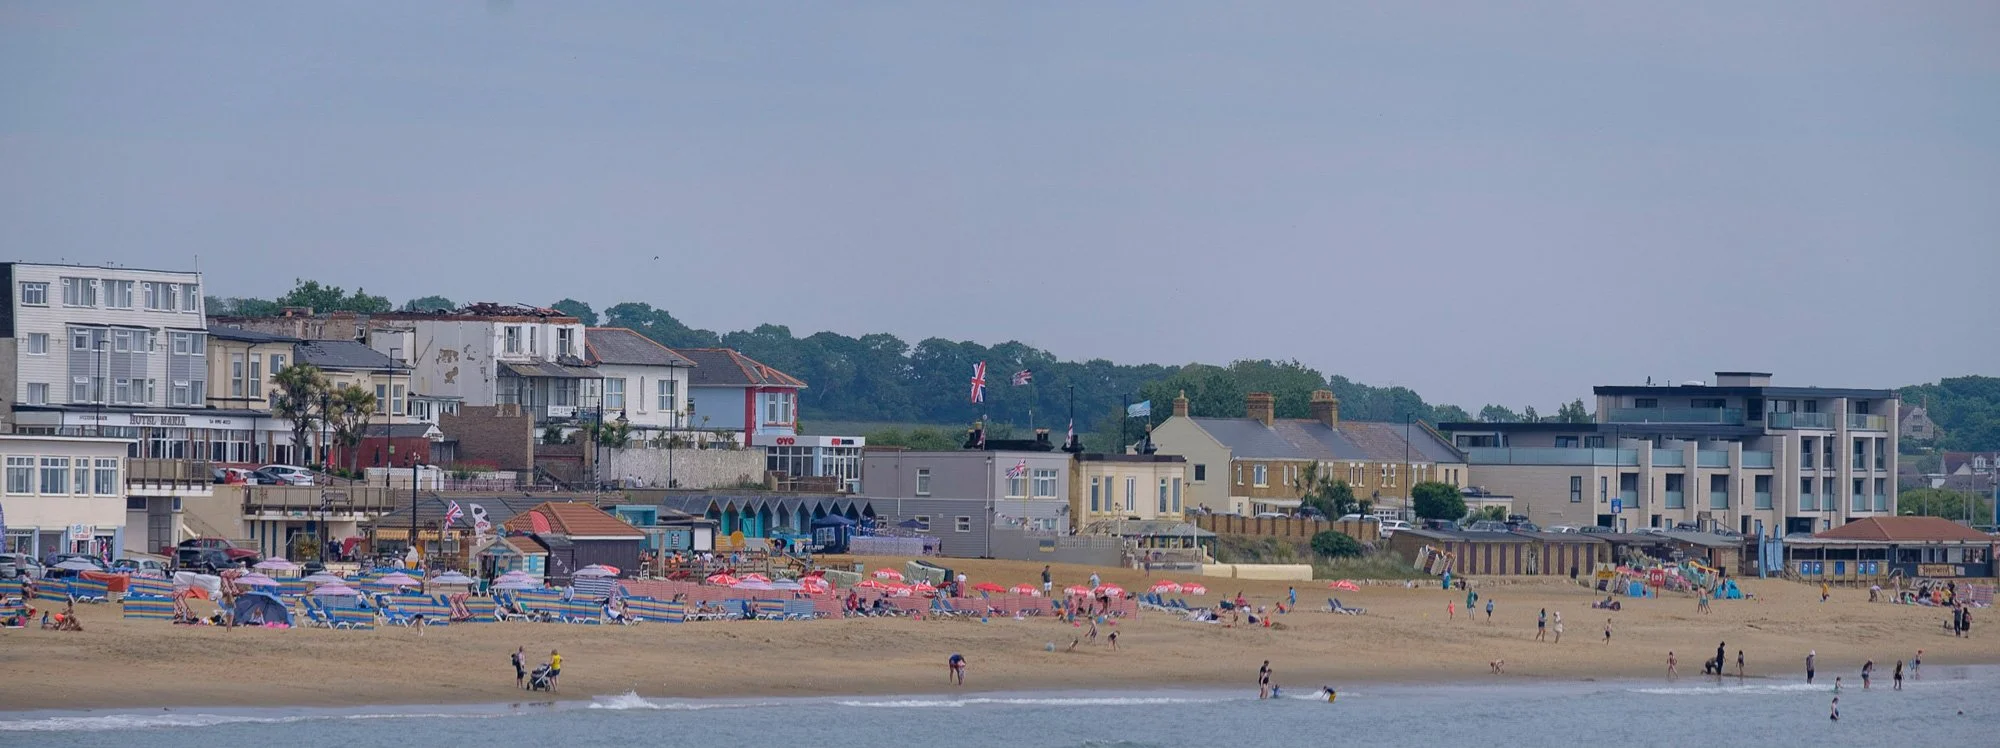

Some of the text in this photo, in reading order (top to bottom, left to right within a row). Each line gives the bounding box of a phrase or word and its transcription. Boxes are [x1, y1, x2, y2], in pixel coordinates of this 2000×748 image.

[129, 414, 187, 426] HOTEL MARIA
[776, 437, 795, 445] OYO
